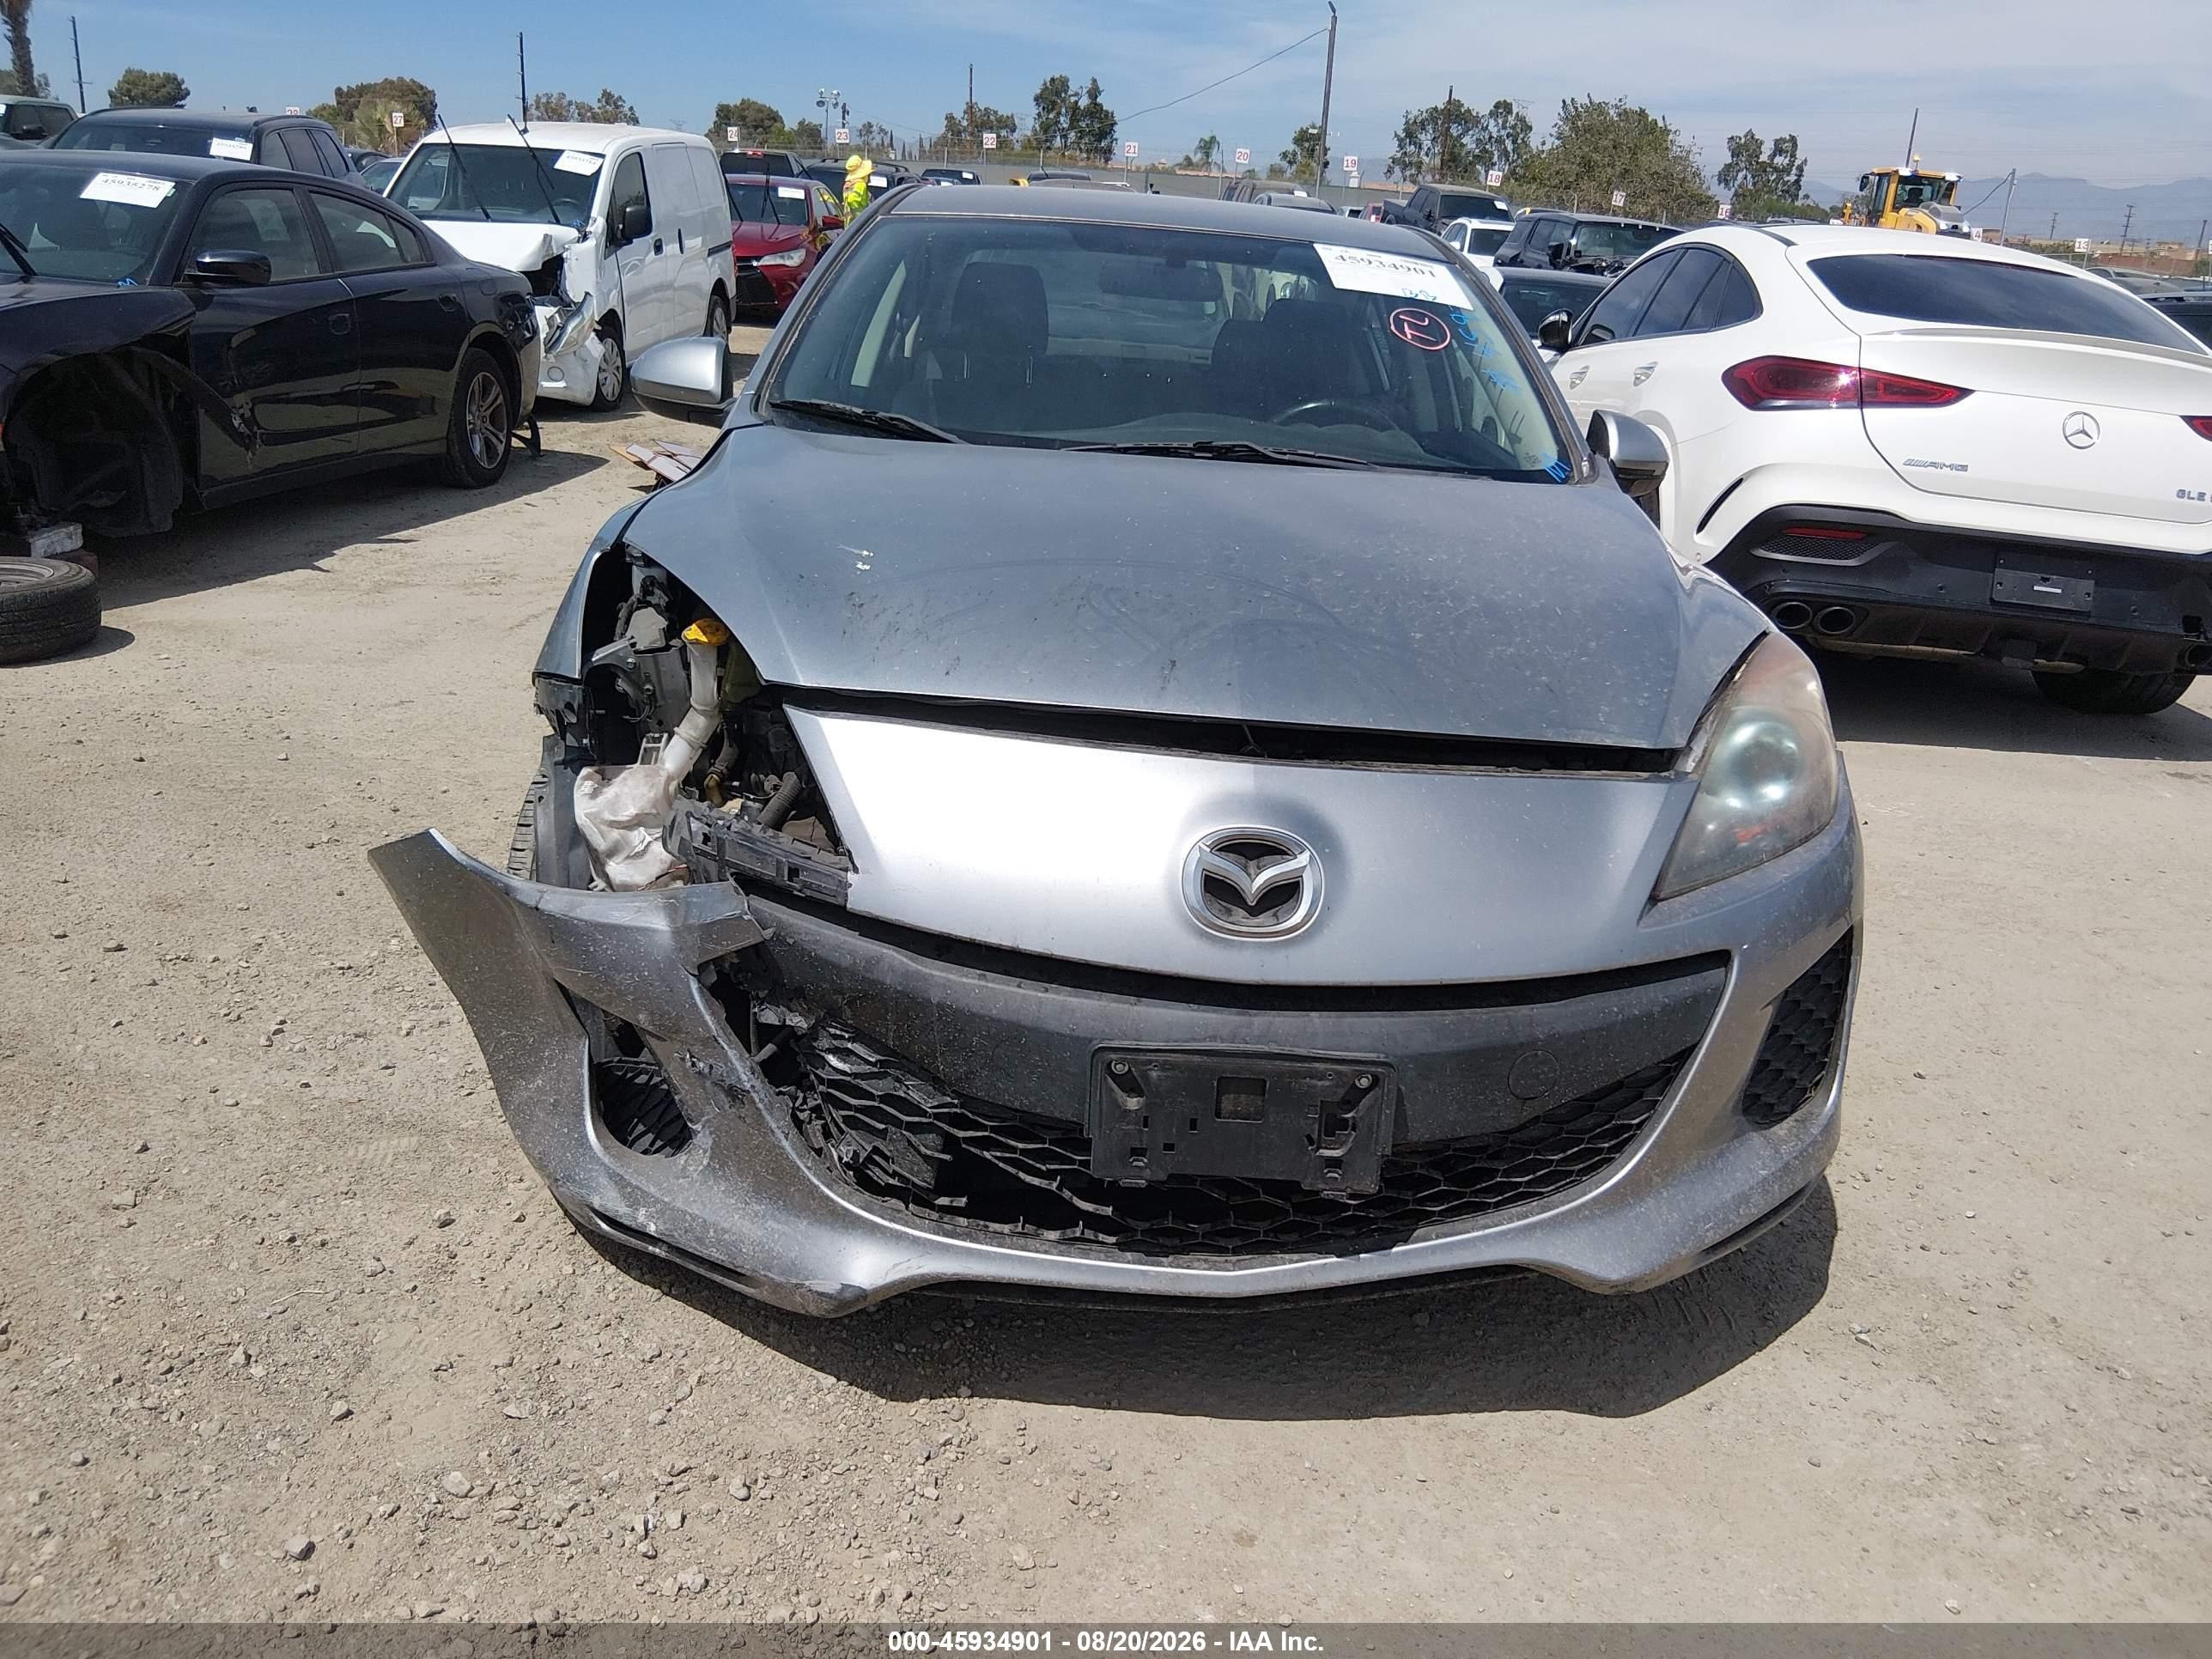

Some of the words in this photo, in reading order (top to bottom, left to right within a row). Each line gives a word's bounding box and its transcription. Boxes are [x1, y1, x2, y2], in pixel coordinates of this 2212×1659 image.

[393, 116, 403, 125] 27
[728, 131, 738, 139] 24
[836, 132, 848, 141] 23
[984, 137, 995, 146] 22
[1127, 145, 1137, 154] 21
[1237, 151, 1249, 161] 20
[1345, 159, 1356, 168] 19
[1488, 174, 1501, 183] 18
[1613, 194, 1624, 204] 17
[2076, 241, 2088, 250] 13
[1334, 254, 1436, 278] 45934901
[1926, 460, 1969, 472] AMG
[2176, 489, 2206, 502] GLE
